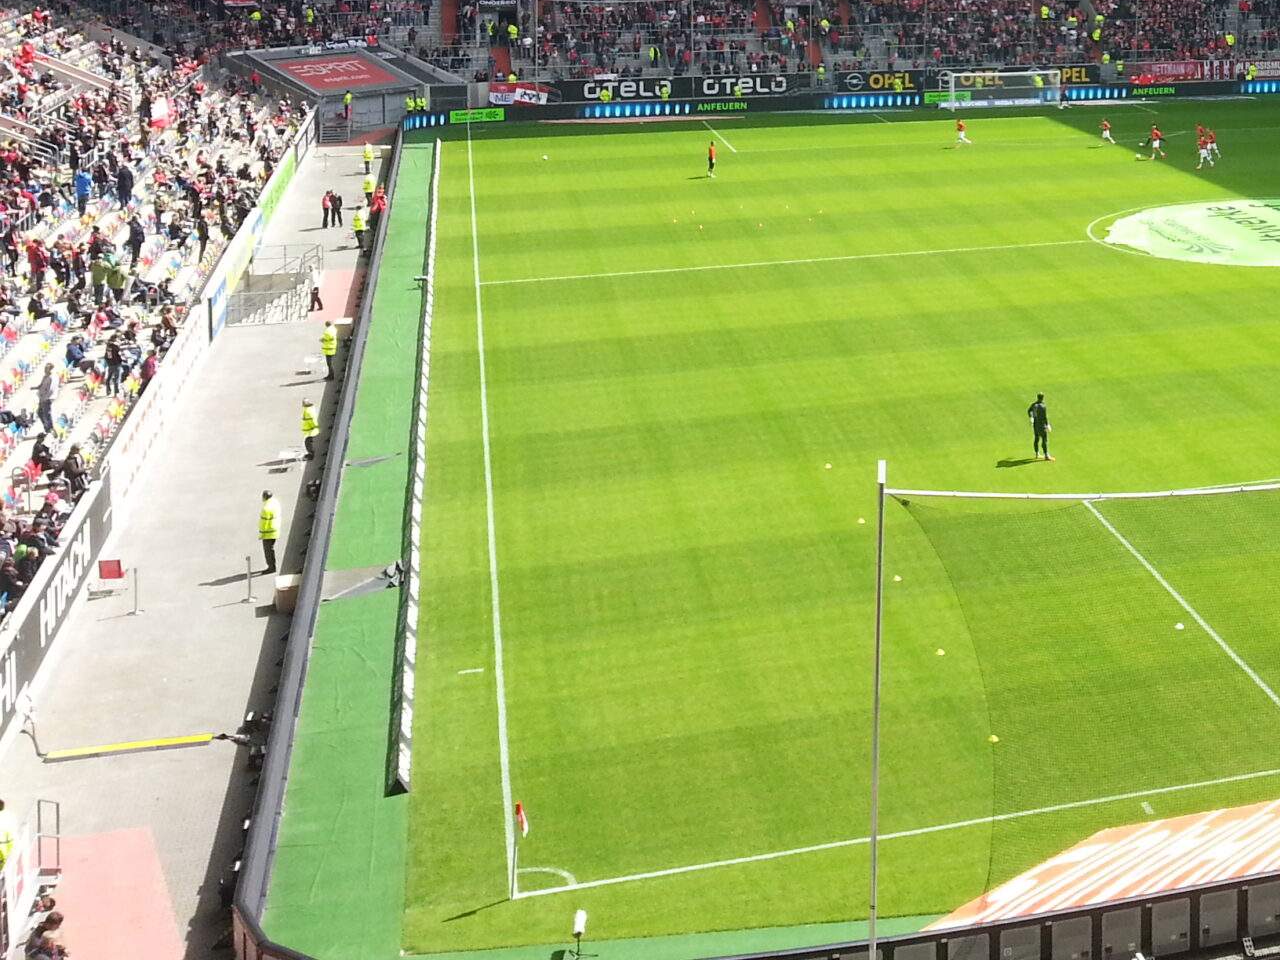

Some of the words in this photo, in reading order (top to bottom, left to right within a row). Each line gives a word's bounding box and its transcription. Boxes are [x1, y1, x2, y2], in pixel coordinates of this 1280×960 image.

[288, 60, 367, 77] ESPRIT
[1131, 86, 1176, 95] ANFEUERN
[697, 102, 748, 112] ANFEUERN
[39, 518, 91, 648] HITACHI
